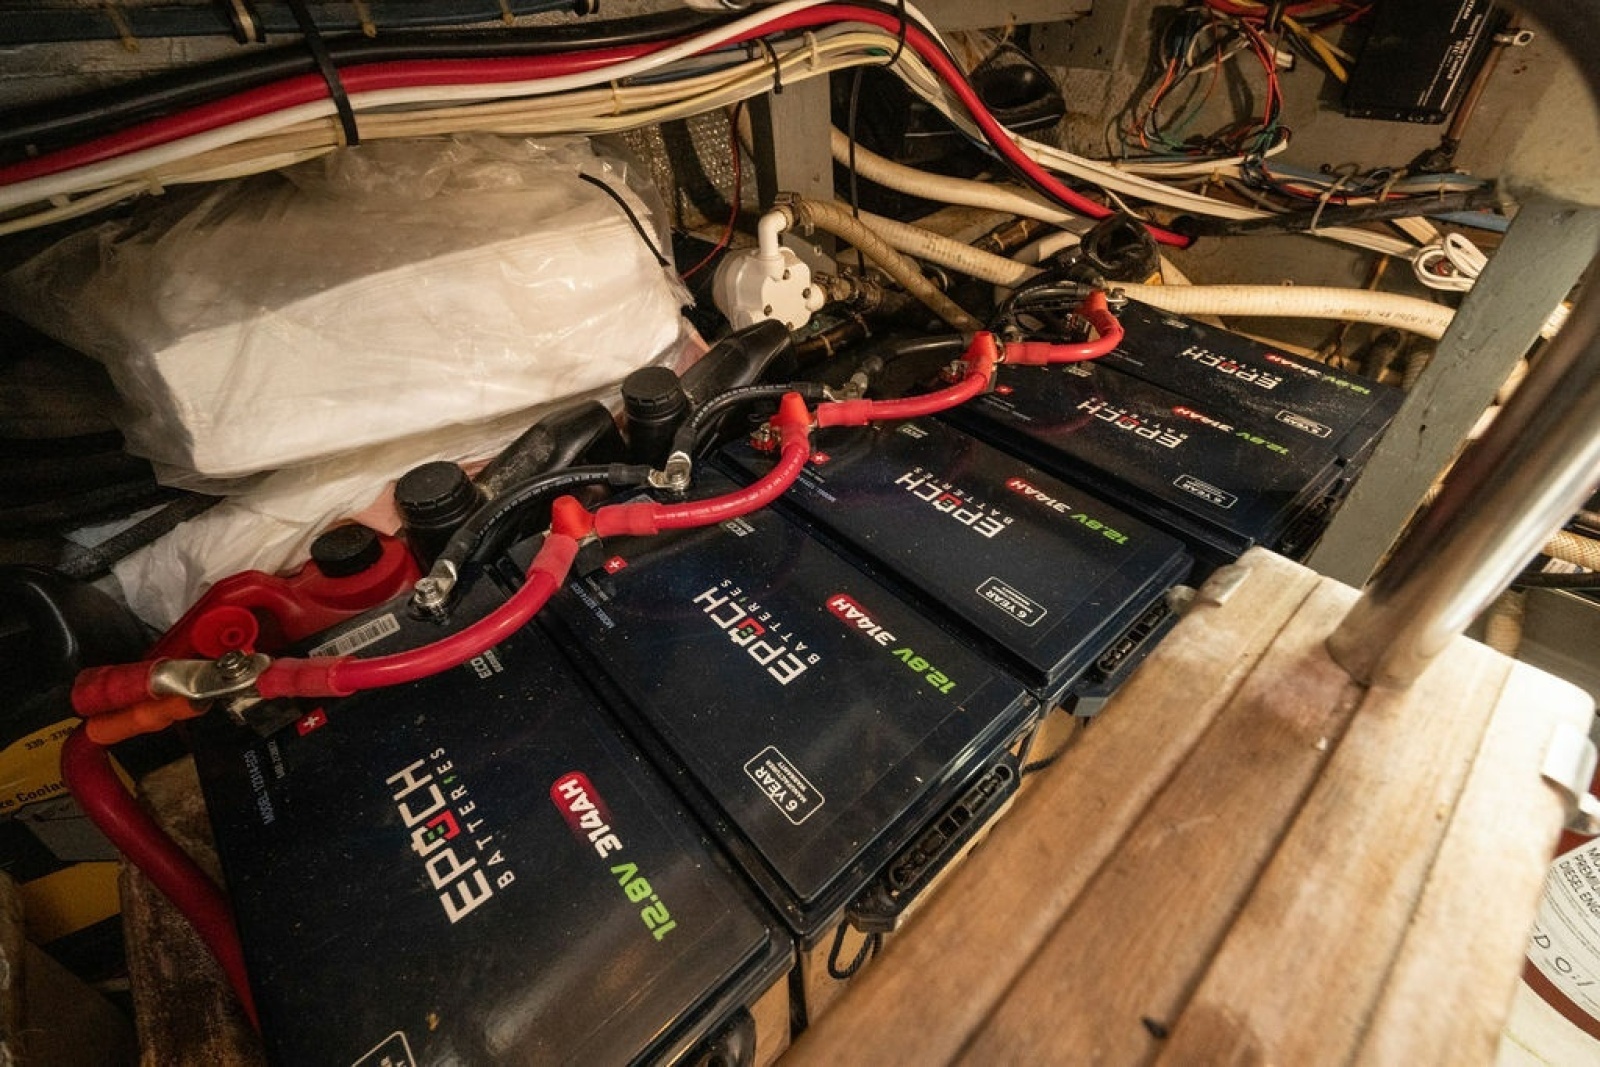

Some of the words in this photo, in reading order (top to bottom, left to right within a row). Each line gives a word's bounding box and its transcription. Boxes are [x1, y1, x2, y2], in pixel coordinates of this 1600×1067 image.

[1076, 400, 1183, 449] EPOCH
[894, 472, 1006, 539] EPOCH
[1009, 480, 1072, 513] 314AH
[1069, 513, 1129, 545] 12.8V
[719, 578, 821, 665] BATTERIES
[830, 597, 897, 646] 314AH
[985, 589, 1016, 614] YEAR
[692, 586, 808, 686] EPOCH
[470, 656, 493, 679] ECO
[891, 647, 957, 695] 12.8V
[755, 766, 787, 803] YEAR
[785, 799, 798, 812] 6
[385, 758, 493, 924] EPOCH
[430, 747, 516, 890] BATTERIES
[557, 778, 623, 859] 314AH
[1559, 861, 1585, 893] DIESEL
[611, 862, 677, 942] 12.8V
